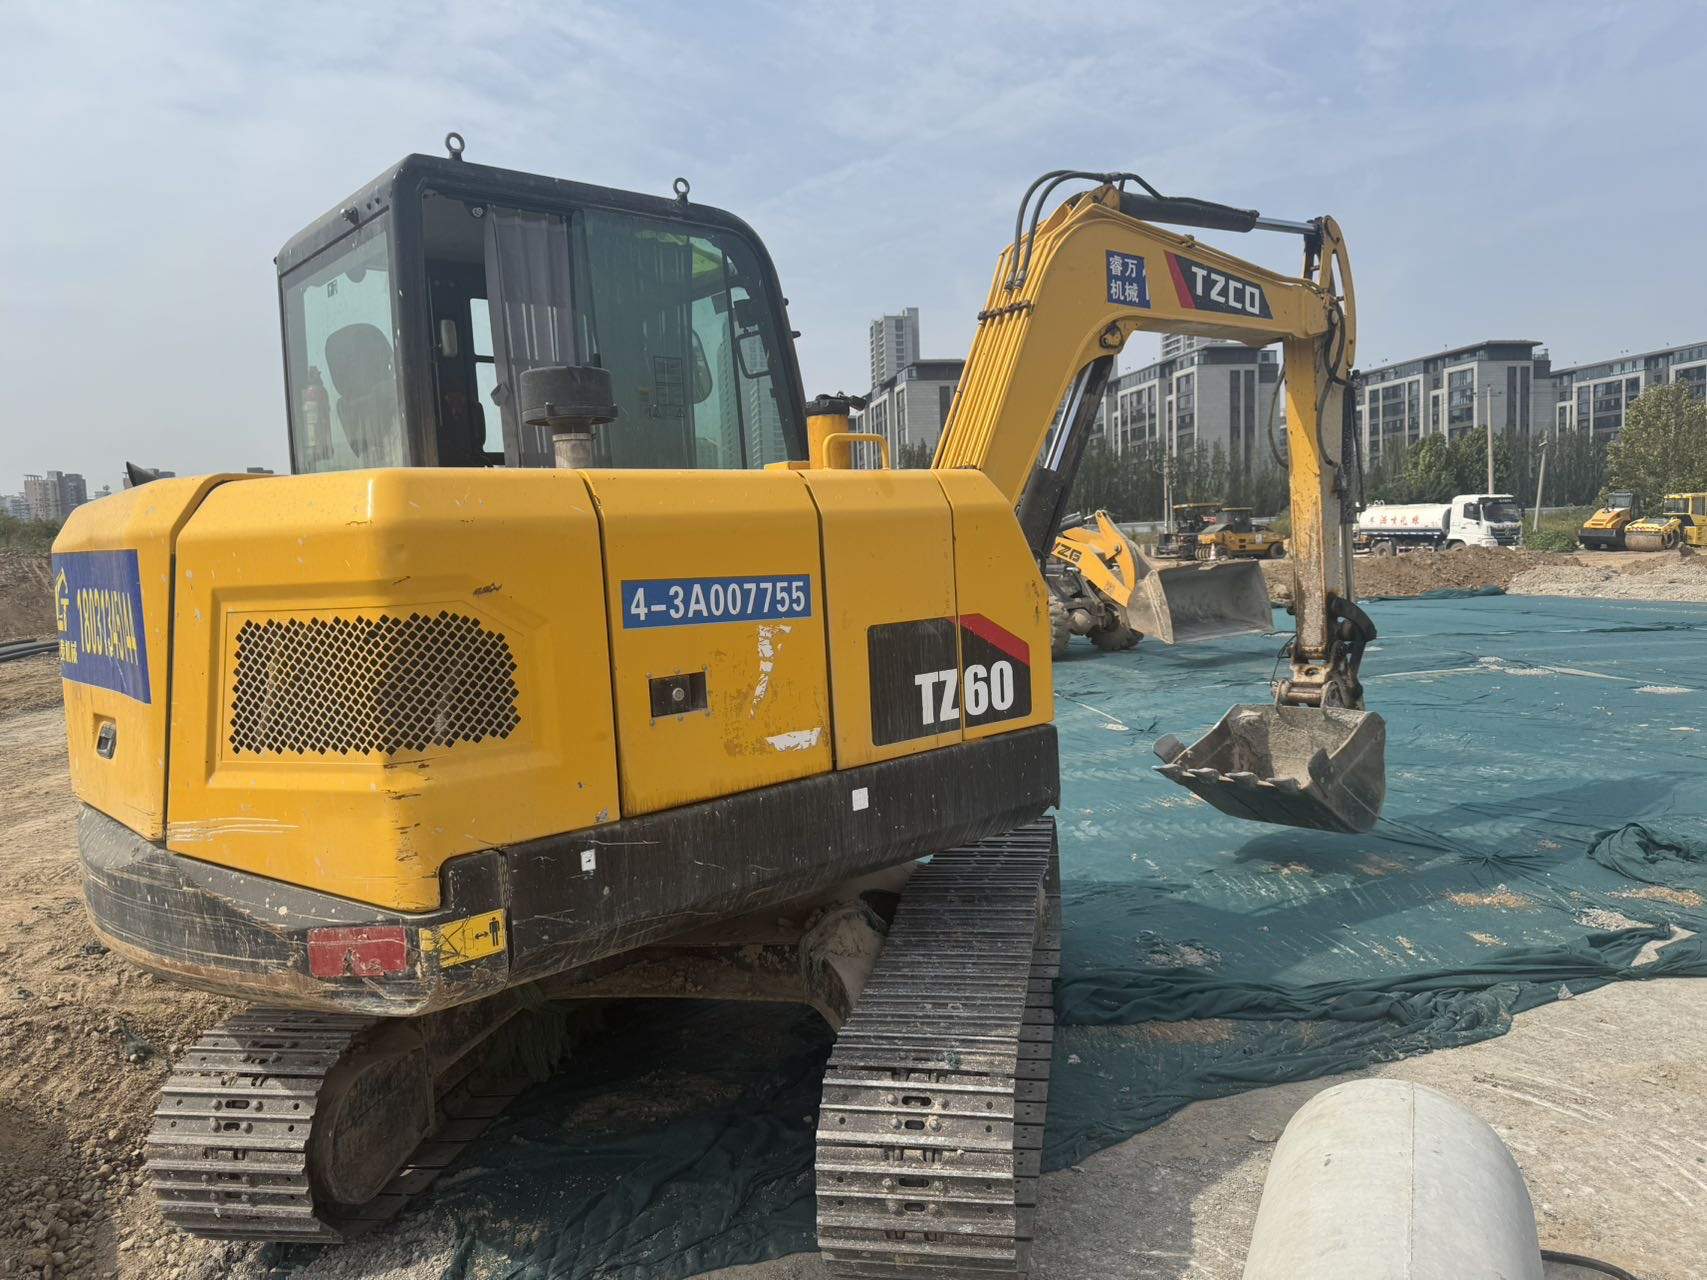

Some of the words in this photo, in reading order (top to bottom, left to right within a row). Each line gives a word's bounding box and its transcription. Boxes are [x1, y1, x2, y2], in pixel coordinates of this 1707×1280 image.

[1110, 280, 1139, 303] 机械
[1192, 266, 1260, 315] TZCO
[630, 581, 806, 621] 4-3A007755
[914, 660, 1014, 725] TZ60
